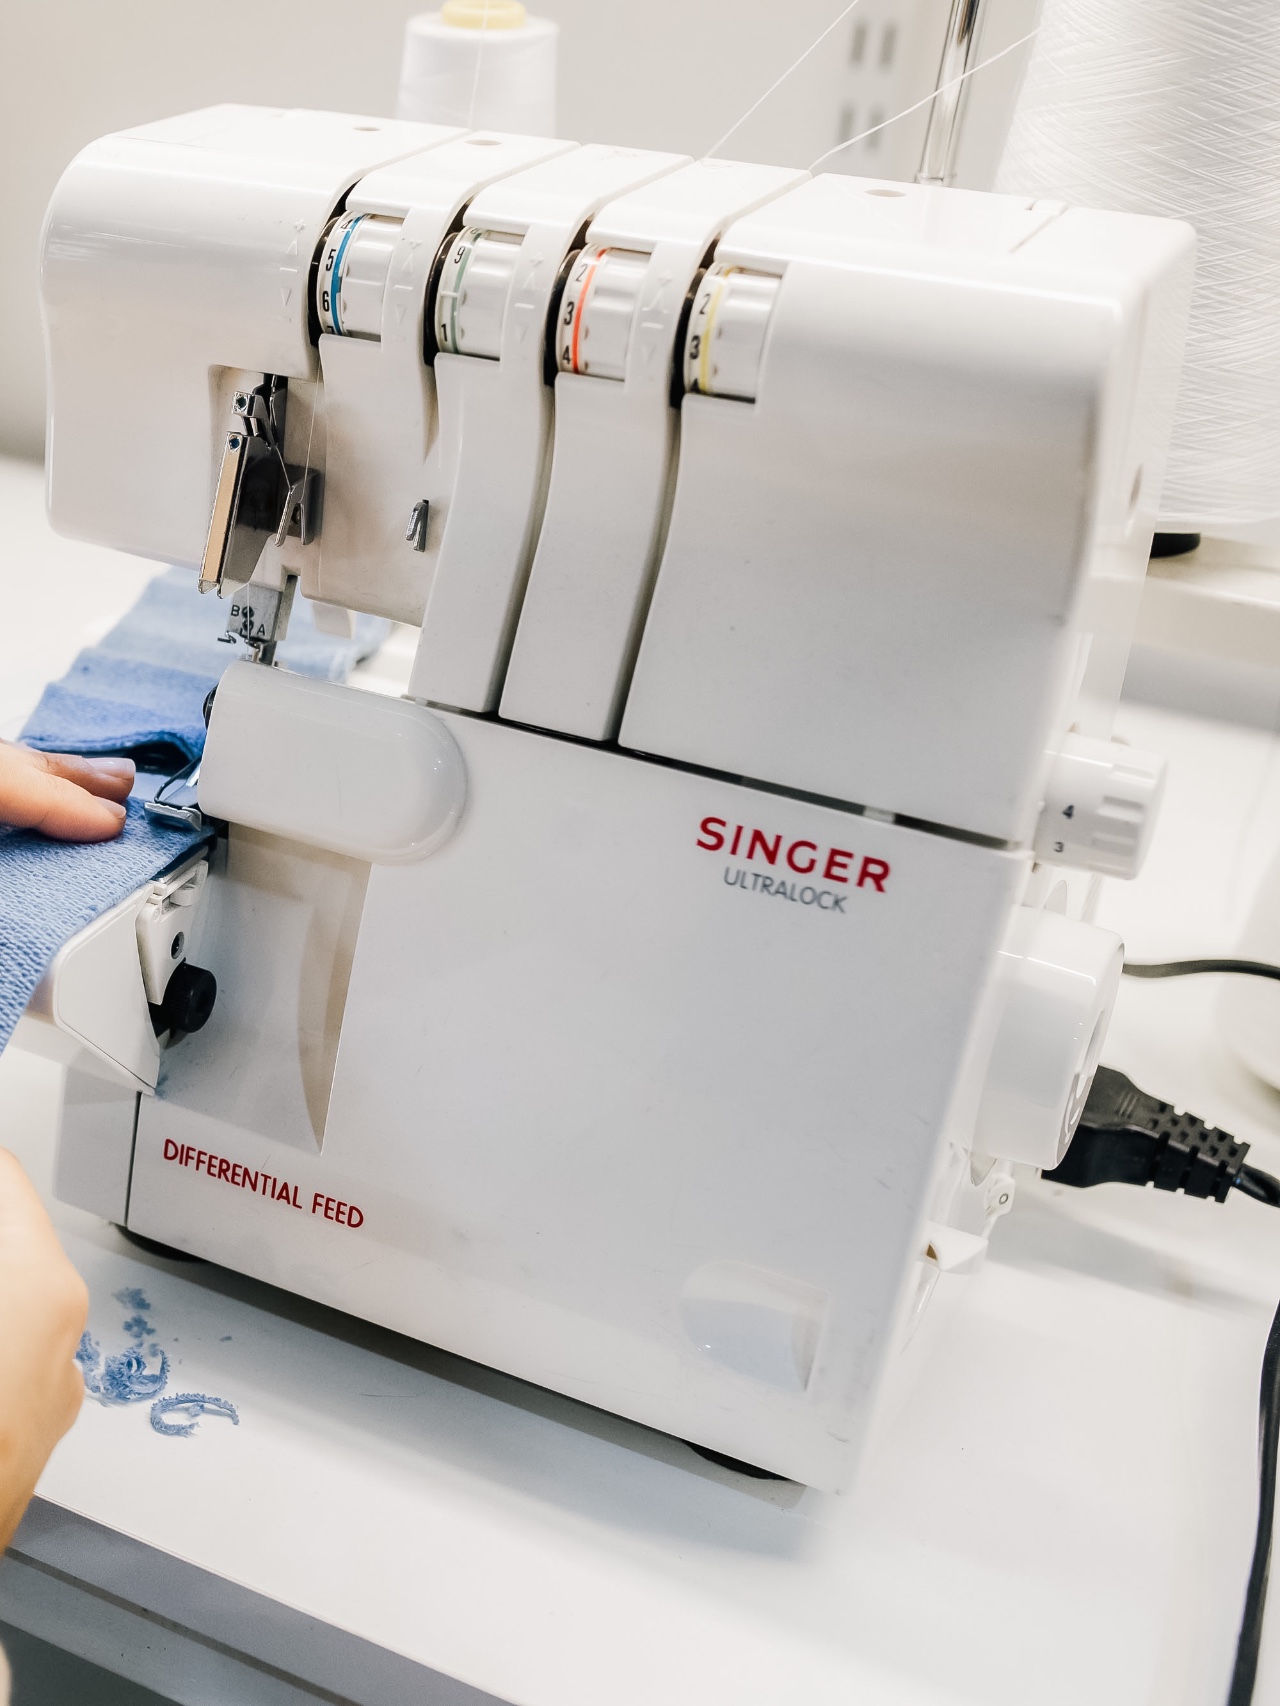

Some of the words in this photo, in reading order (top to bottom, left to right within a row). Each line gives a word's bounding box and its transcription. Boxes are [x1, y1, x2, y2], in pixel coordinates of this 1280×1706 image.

[325, 248, 336, 272] 5
[454, 245, 466, 264] 9
[575, 262, 589, 282] 2
[322, 290, 330, 312] 6
[699, 293, 711, 315] 2
[563, 301, 575, 326] 3
[441, 323, 448, 342] 1
[562, 345, 571, 365] 4
[689, 334, 701, 360] 3
[231, 604, 241, 617] B
[257, 623, 266, 636] A
[696, 816, 891, 893] SINGER
[723, 866, 848, 914] ULTRALOCK
[163, 1138, 303, 1209] DIFFERENTIAL
[311, 1192, 364, 1228] FEED
